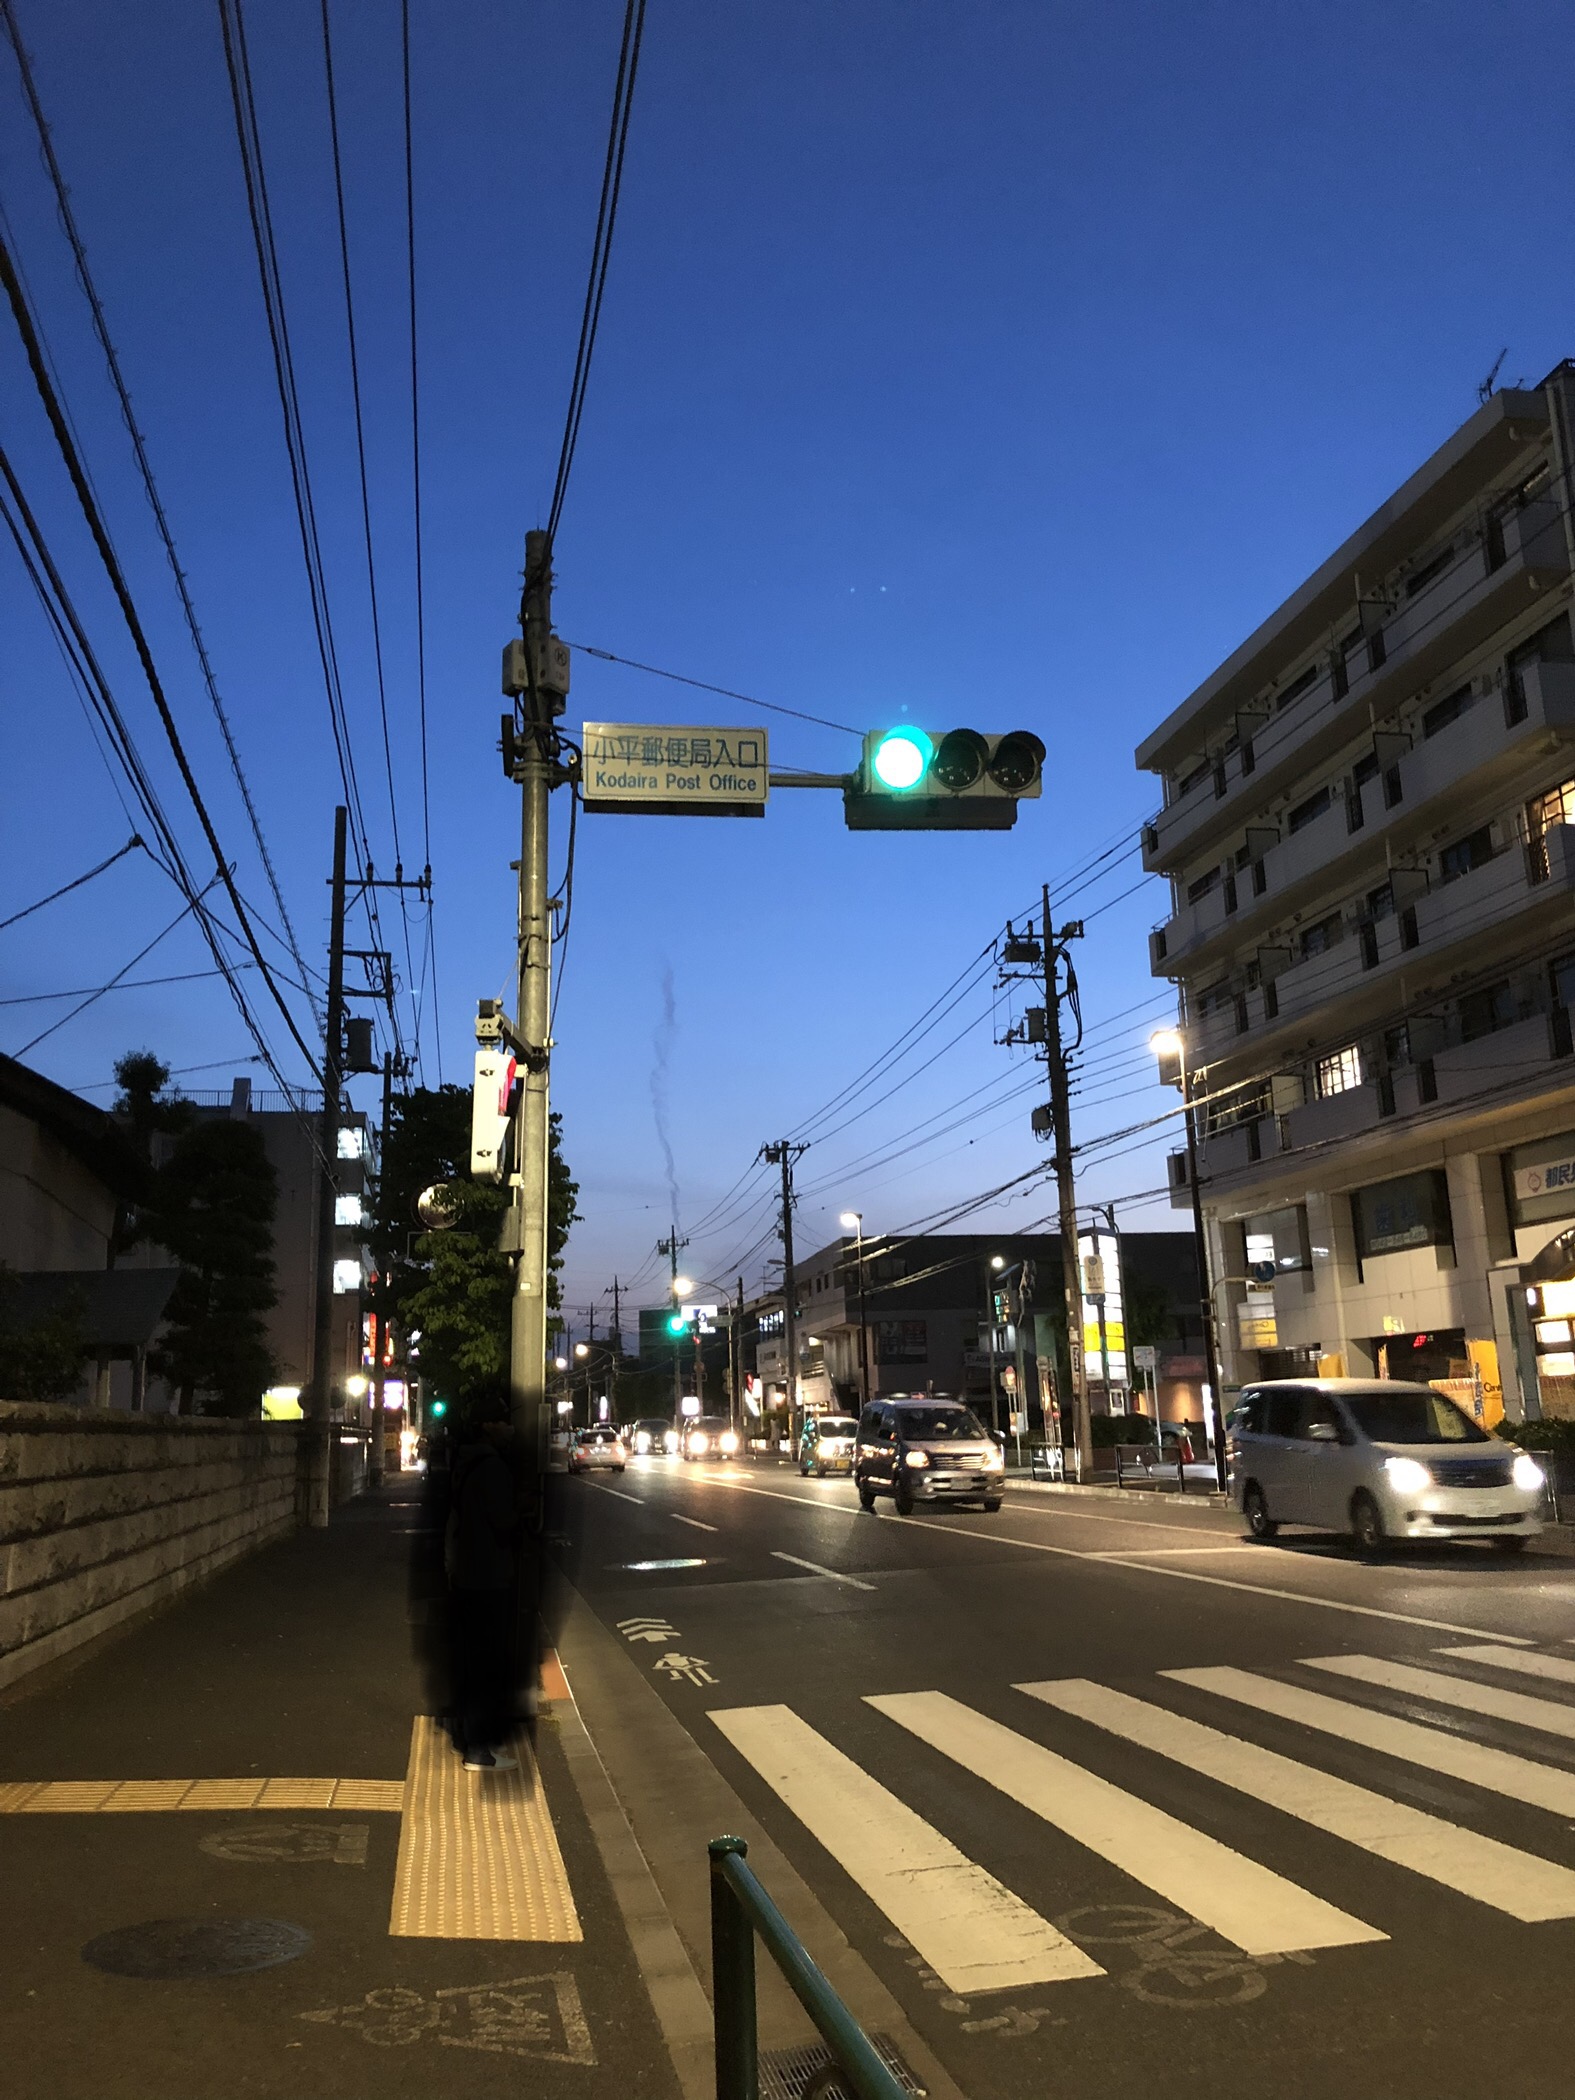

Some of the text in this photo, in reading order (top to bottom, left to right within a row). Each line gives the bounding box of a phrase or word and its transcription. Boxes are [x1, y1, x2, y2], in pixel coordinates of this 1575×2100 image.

[593, 735, 758, 768] 小平郵便局入口
[596, 771, 756, 792] Kodaira Post Office
[1545, 1161, 1575, 1188] 都民
